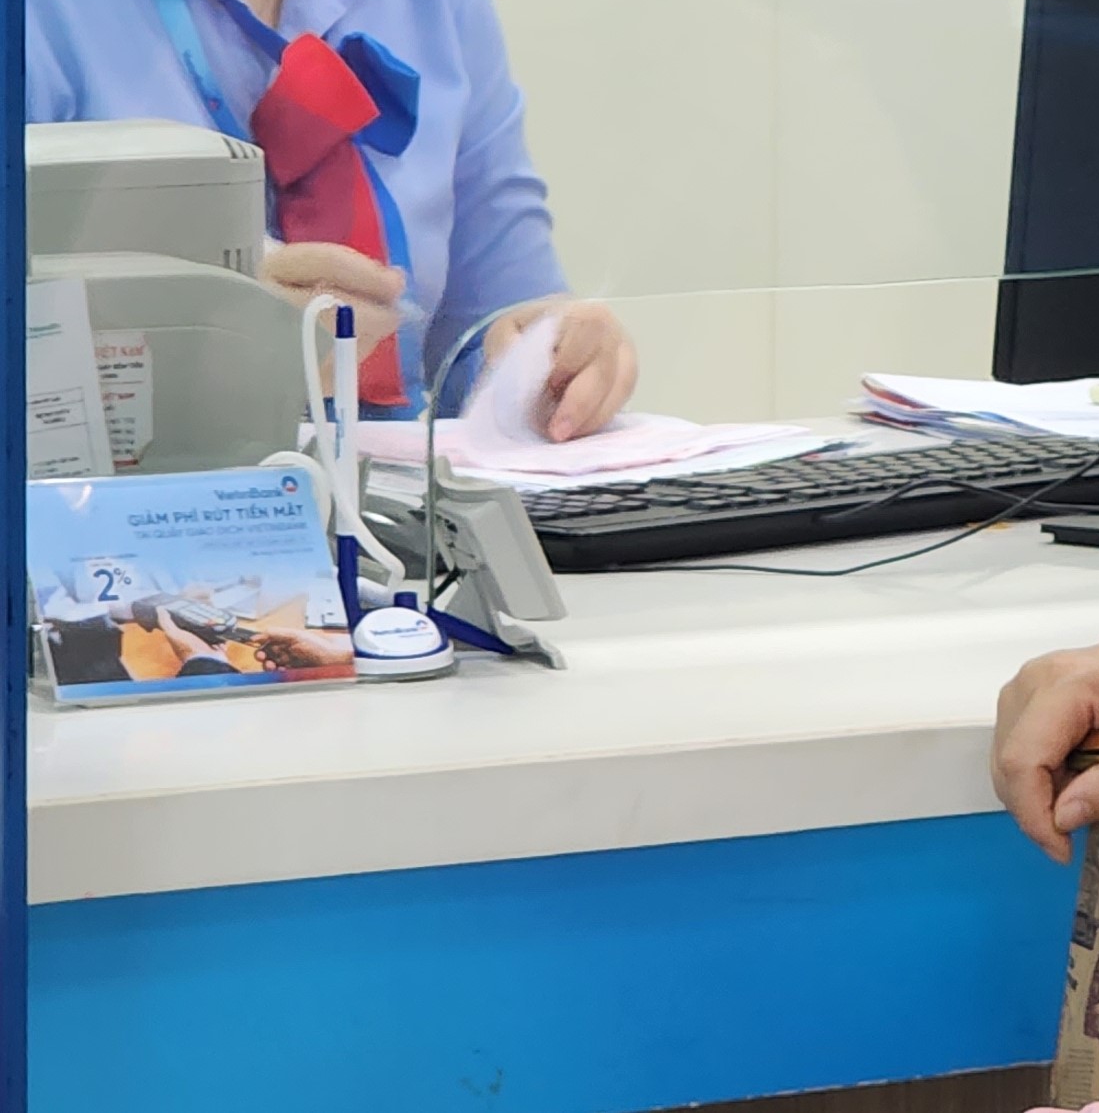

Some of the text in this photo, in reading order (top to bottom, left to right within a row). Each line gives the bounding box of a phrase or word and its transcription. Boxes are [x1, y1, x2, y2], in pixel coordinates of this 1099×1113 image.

[214, 487, 283, 501] VietinBank
[127, 502, 304, 527] GIẢM PHÍ RÚT TIỀN MẶT
[93, 568, 132, 602] 2%
